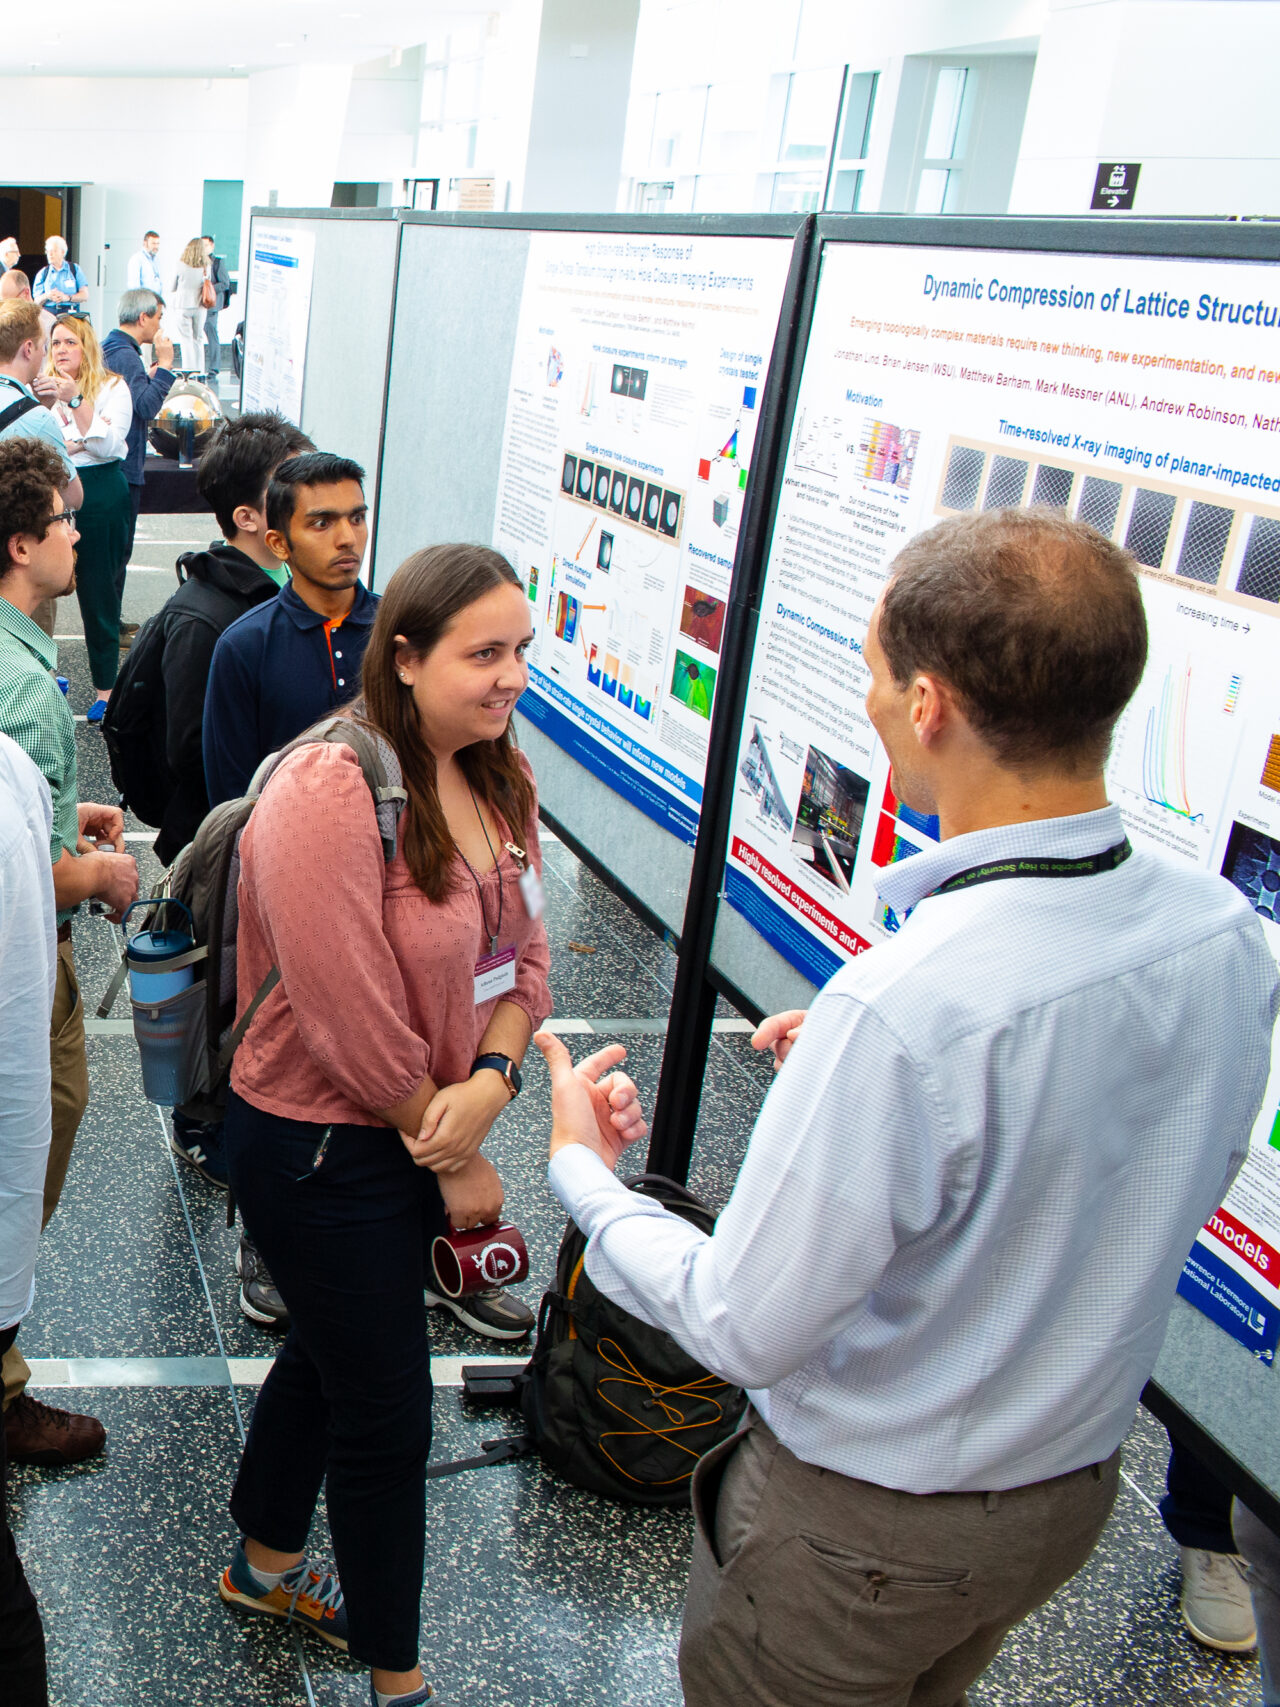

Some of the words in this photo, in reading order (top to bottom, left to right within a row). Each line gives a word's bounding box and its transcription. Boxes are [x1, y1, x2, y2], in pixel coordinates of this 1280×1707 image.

[708, 270, 754, 291] Experiments
[924, 274, 983, 301] Dynamic
[988, 278, 1095, 310] Compression
[1100, 288, 1122, 312] of
[1123, 289, 1190, 319] Lattice
[850, 316, 882, 333] Emerging
[884, 321, 929, 339] topologically
[931, 327, 964, 343] complex
[966, 331, 1004, 347] materials
[1006, 336, 1038, 352] require
[1040, 342, 1060, 354] new
[1061, 342, 1104, 364] thinking,
[1107, 349, 1129, 363] new
[1131, 352, 1227, 379] experimentation,
[1231, 364, 1256, 381] and
[845, 389, 884, 408] Motivation
[883, 354, 902, 368] Brian
[903, 358, 930, 373] Jensen
[960, 367, 995, 384] Matthew
[996, 372, 1033, 391] Barham,
[1035, 379, 1059, 395] Mark
[1061, 382, 1103, 402] Messner
[1140, 396, 1185, 416] Andrew
[1186, 402, 1249, 429] Robinson,
[999, 419, 1071, 448] Time-resolved
[1072, 434, 1102, 457] X-ray
[1104, 441, 1153, 468] imaging
[1155, 452, 1170, 468] of
[1171, 456, 1280, 493] planar-impacted
[688, 543, 717, 565] Recovered
[777, 602, 805, 626] Dynamic
[806, 616, 848, 647] Compression
[848, 637, 862, 654] Sec
[1176, 601, 1219, 627] Increasing
[1220, 616, 1239, 631] time
[601, 720, 623, 744] behavior
[632, 744, 651, 765] inform
[651, 759, 665, 774] new
[664, 766, 687, 790] models
[1238, 810, 1270, 829] Experiments
[1020, 861, 1038, 872] Hey
[1040, 863, 1049, 871] to
[738, 844, 761, 872] Highly
[761, 863, 792, 897] resolved
[791, 891, 839, 936] experiments
[839, 930, 857, 951] and
[1207, 1215, 1270, 1271] models
[1186, 1256, 1215, 1282] awrence
[1216, 1277, 1250, 1312] Livermore
[1210, 1286, 1248, 1323] Laboratory
